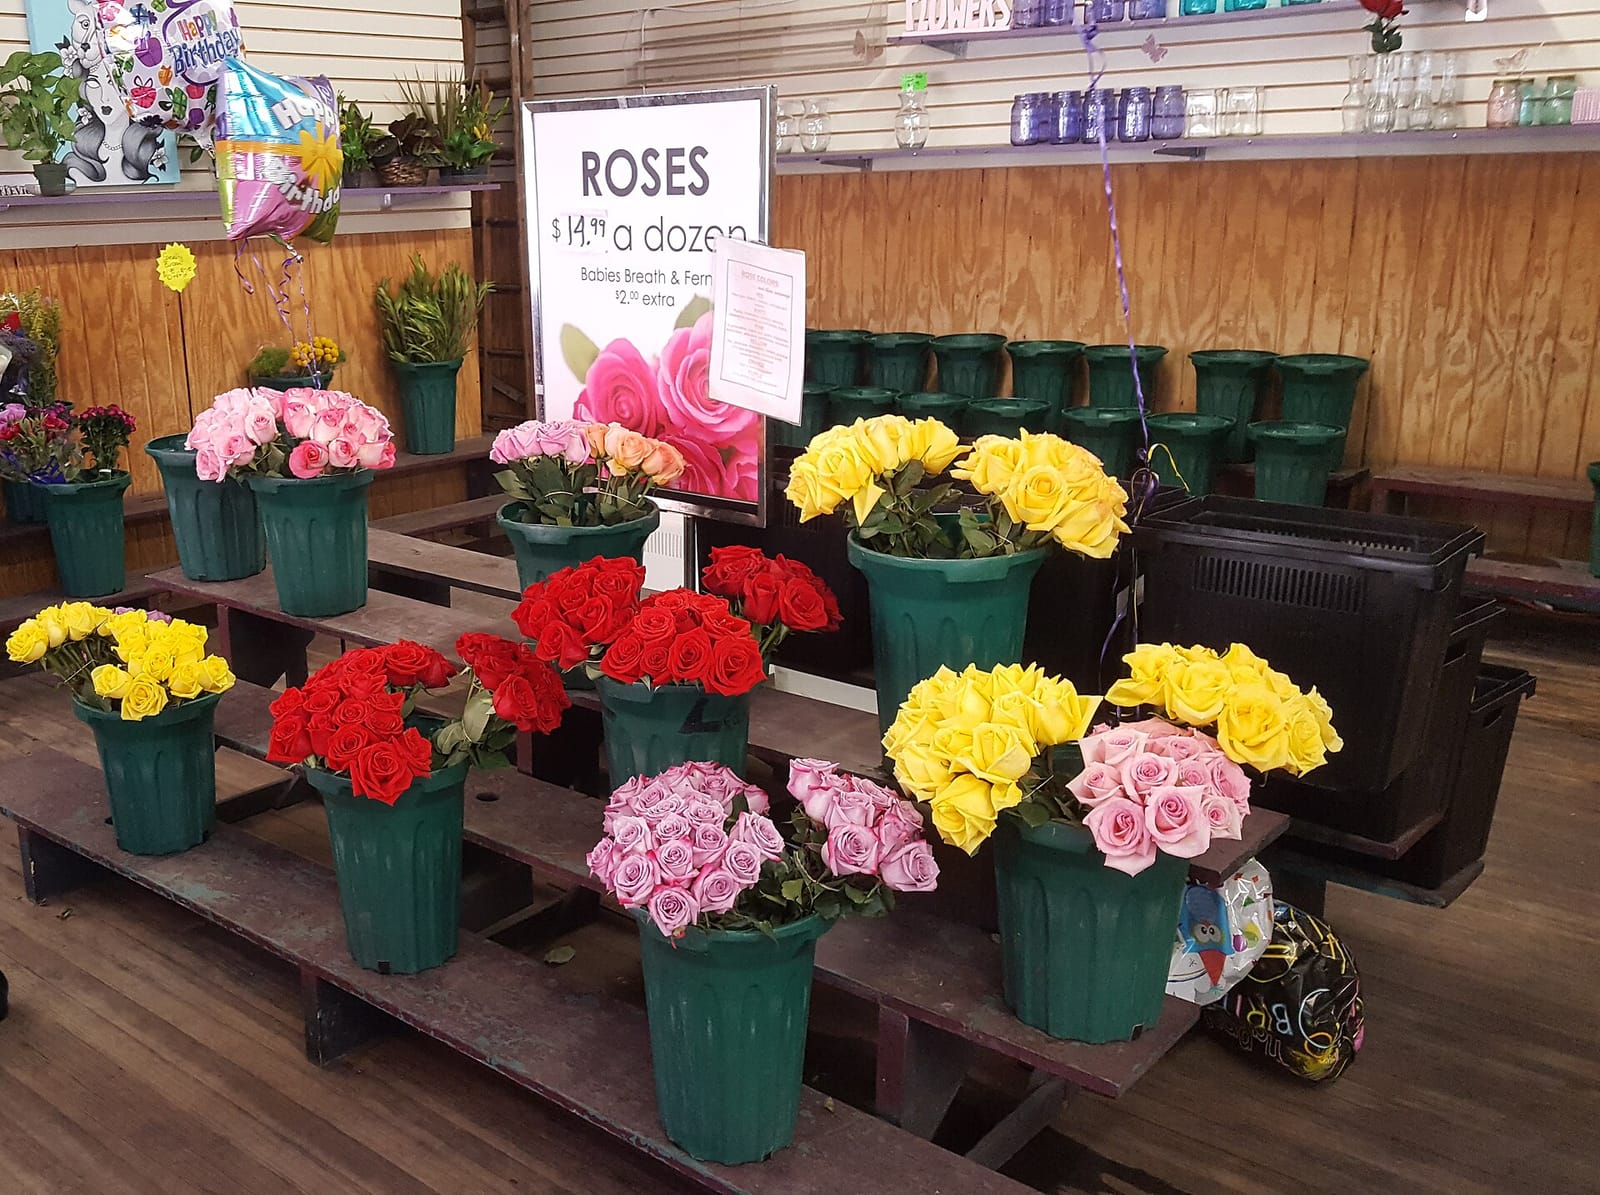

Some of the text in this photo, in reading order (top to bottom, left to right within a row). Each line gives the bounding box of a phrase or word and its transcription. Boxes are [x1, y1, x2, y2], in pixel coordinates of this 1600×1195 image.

[177, 10, 218, 41] Happy
[168, 28, 240, 77] Birthday
[581, 146, 710, 197] ROSES
[613, 225, 632, 251] a
[644, 216, 747, 252] dozen
[581, 267, 713, 286] Babies Breath & Fern
[615, 289, 675, 307] $2.00 extra
